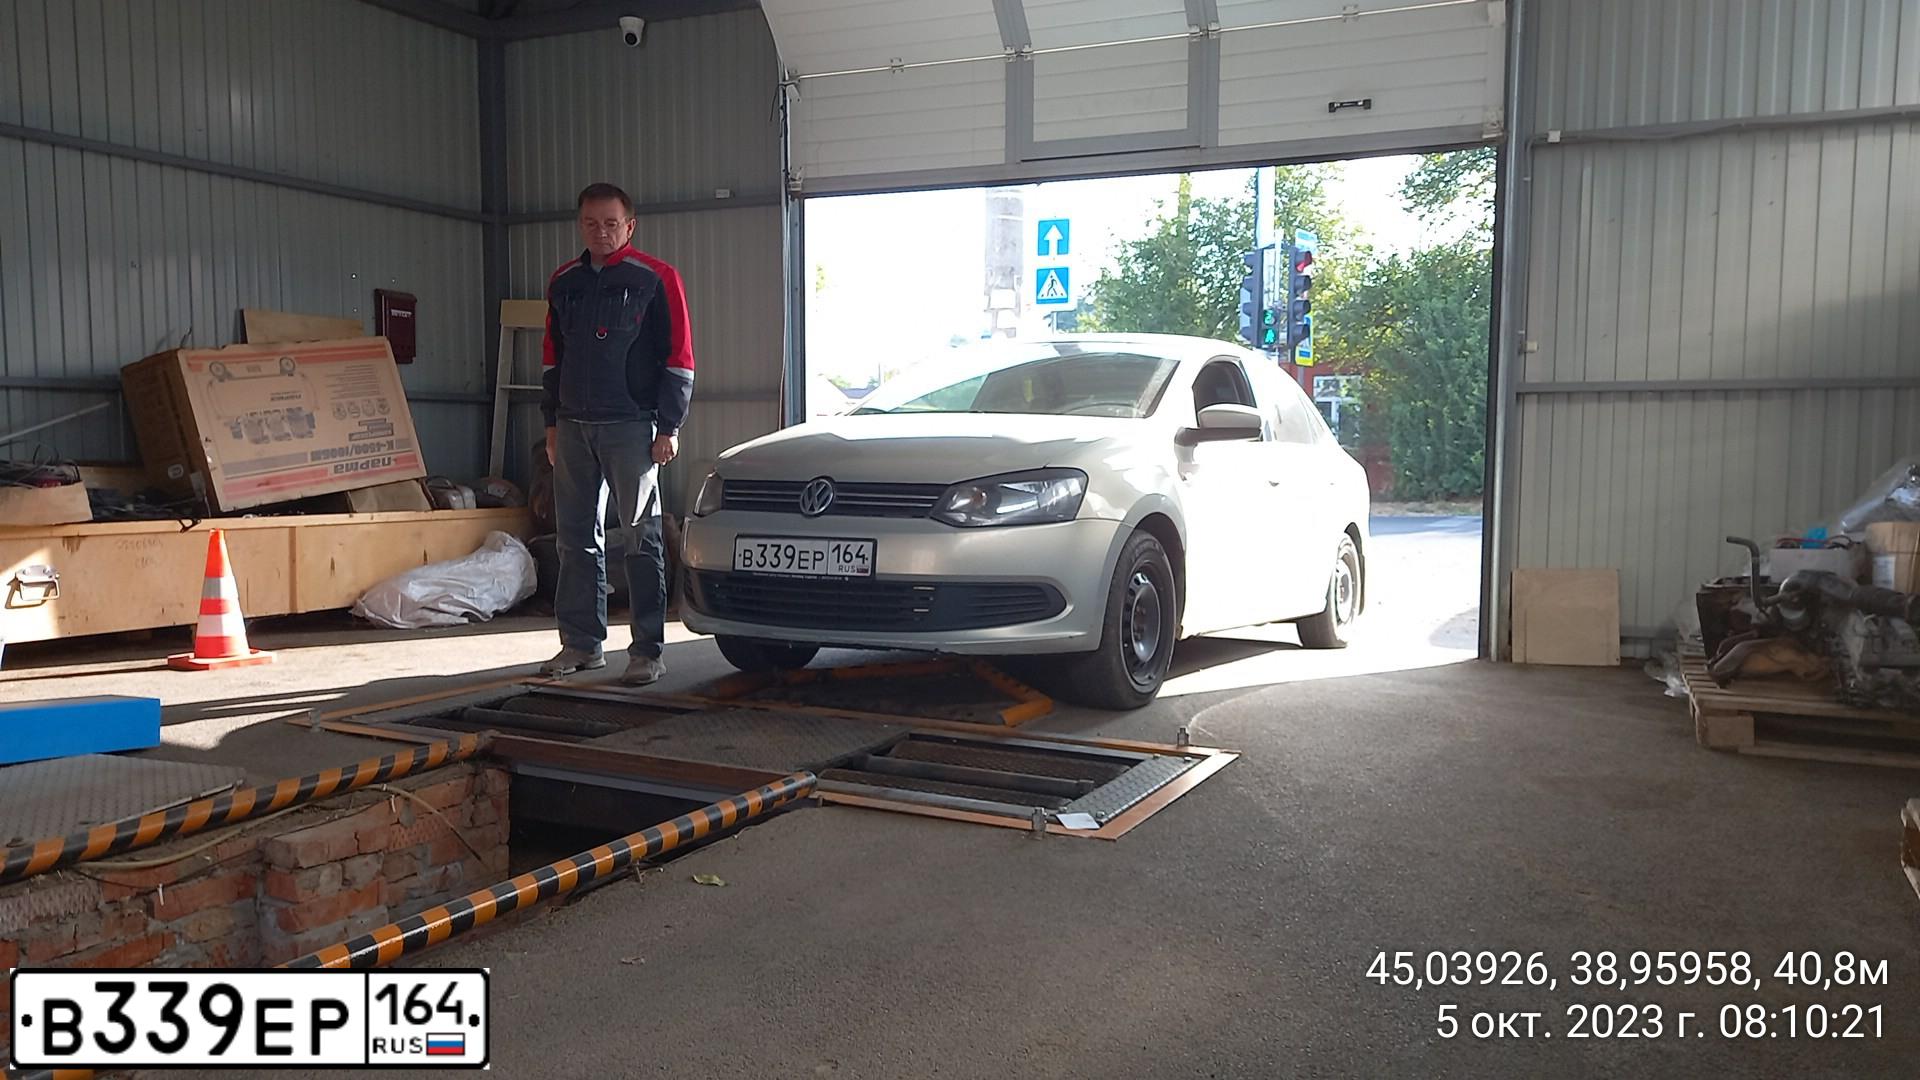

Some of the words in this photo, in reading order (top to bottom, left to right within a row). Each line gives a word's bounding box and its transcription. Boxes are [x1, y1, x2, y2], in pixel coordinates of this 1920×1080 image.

[742, 543, 825, 570] В339ЕР
[831, 543, 867, 565] 164
[838, 564, 857, 574] RUS
